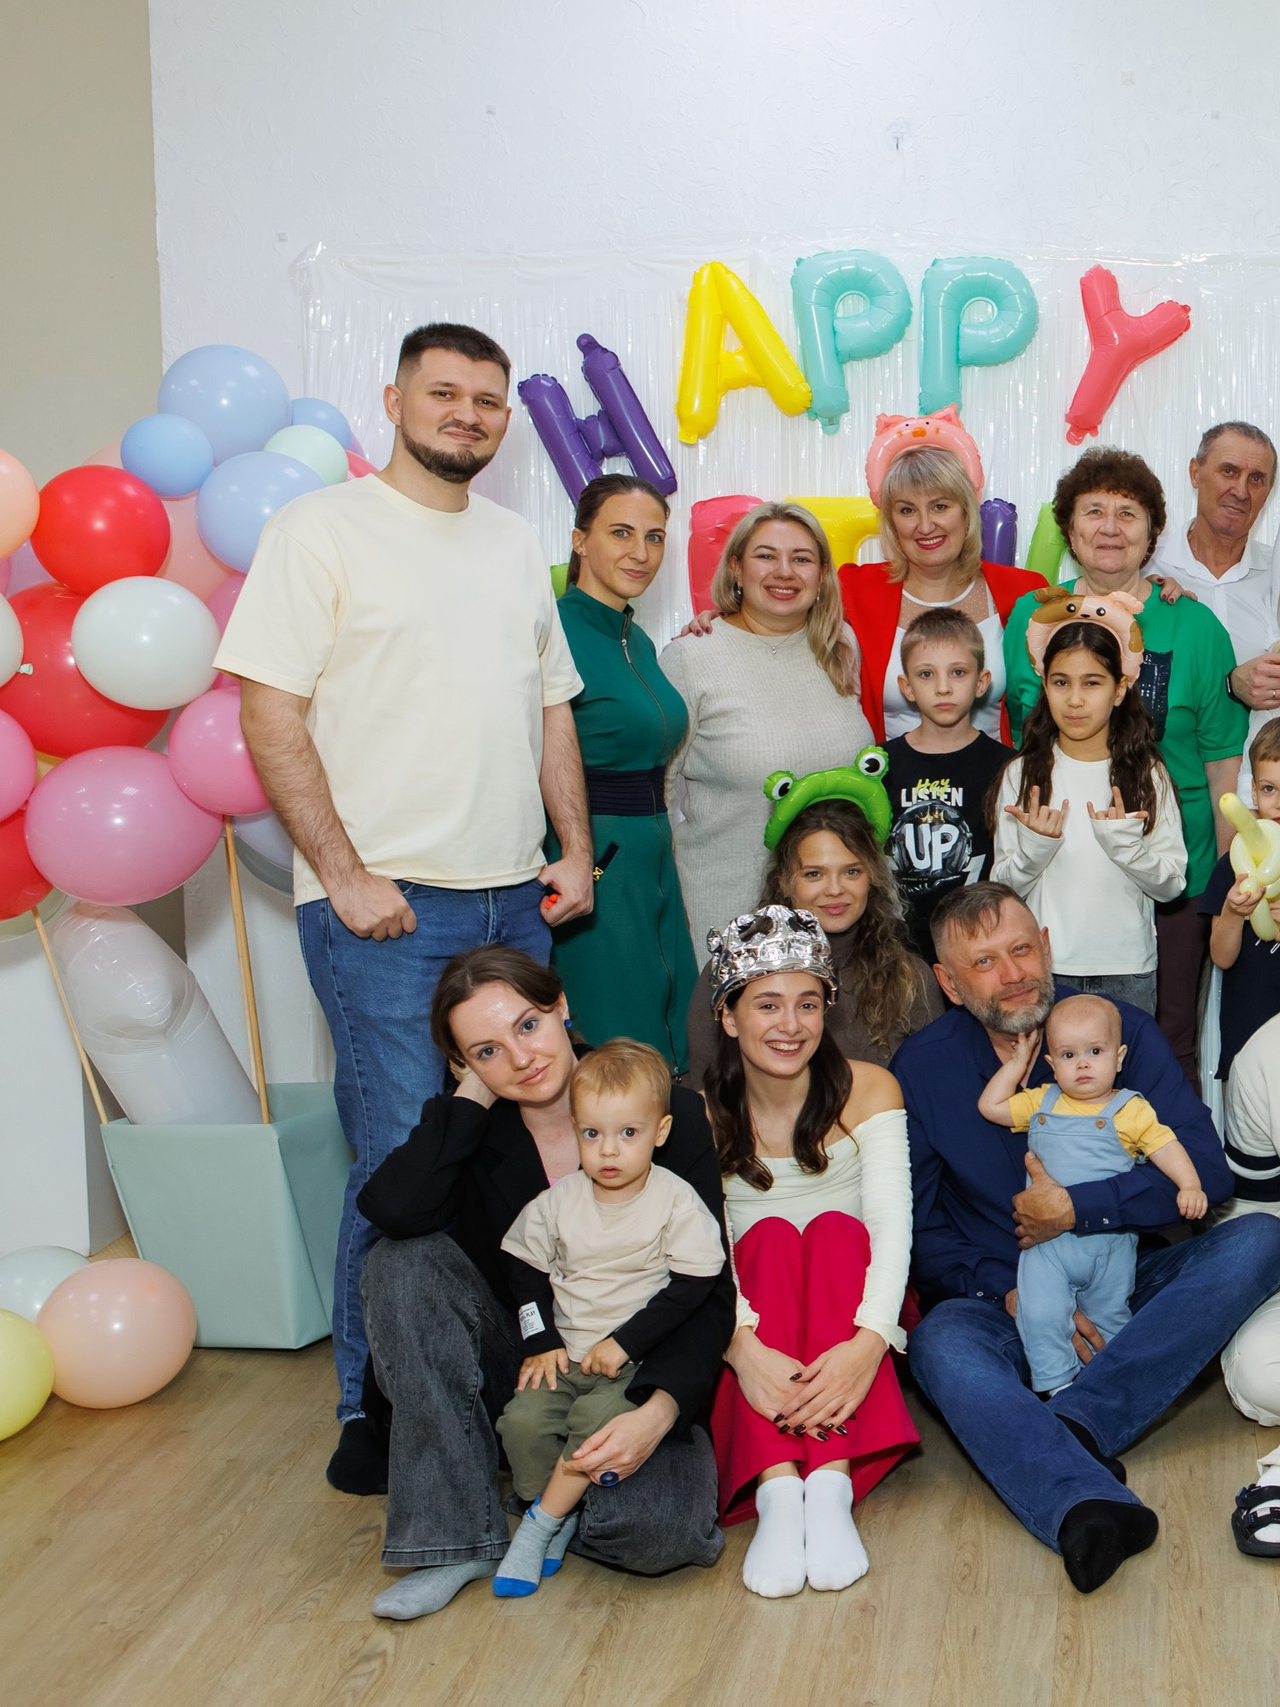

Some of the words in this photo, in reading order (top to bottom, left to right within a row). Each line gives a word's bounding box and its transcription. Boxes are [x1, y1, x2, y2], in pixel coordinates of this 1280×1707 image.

[517, 249, 1191, 508] HAPPY
[901, 787, 963, 808] LISTEN
[914, 778, 951, 797] Hey
[904, 823, 960, 872] UP
